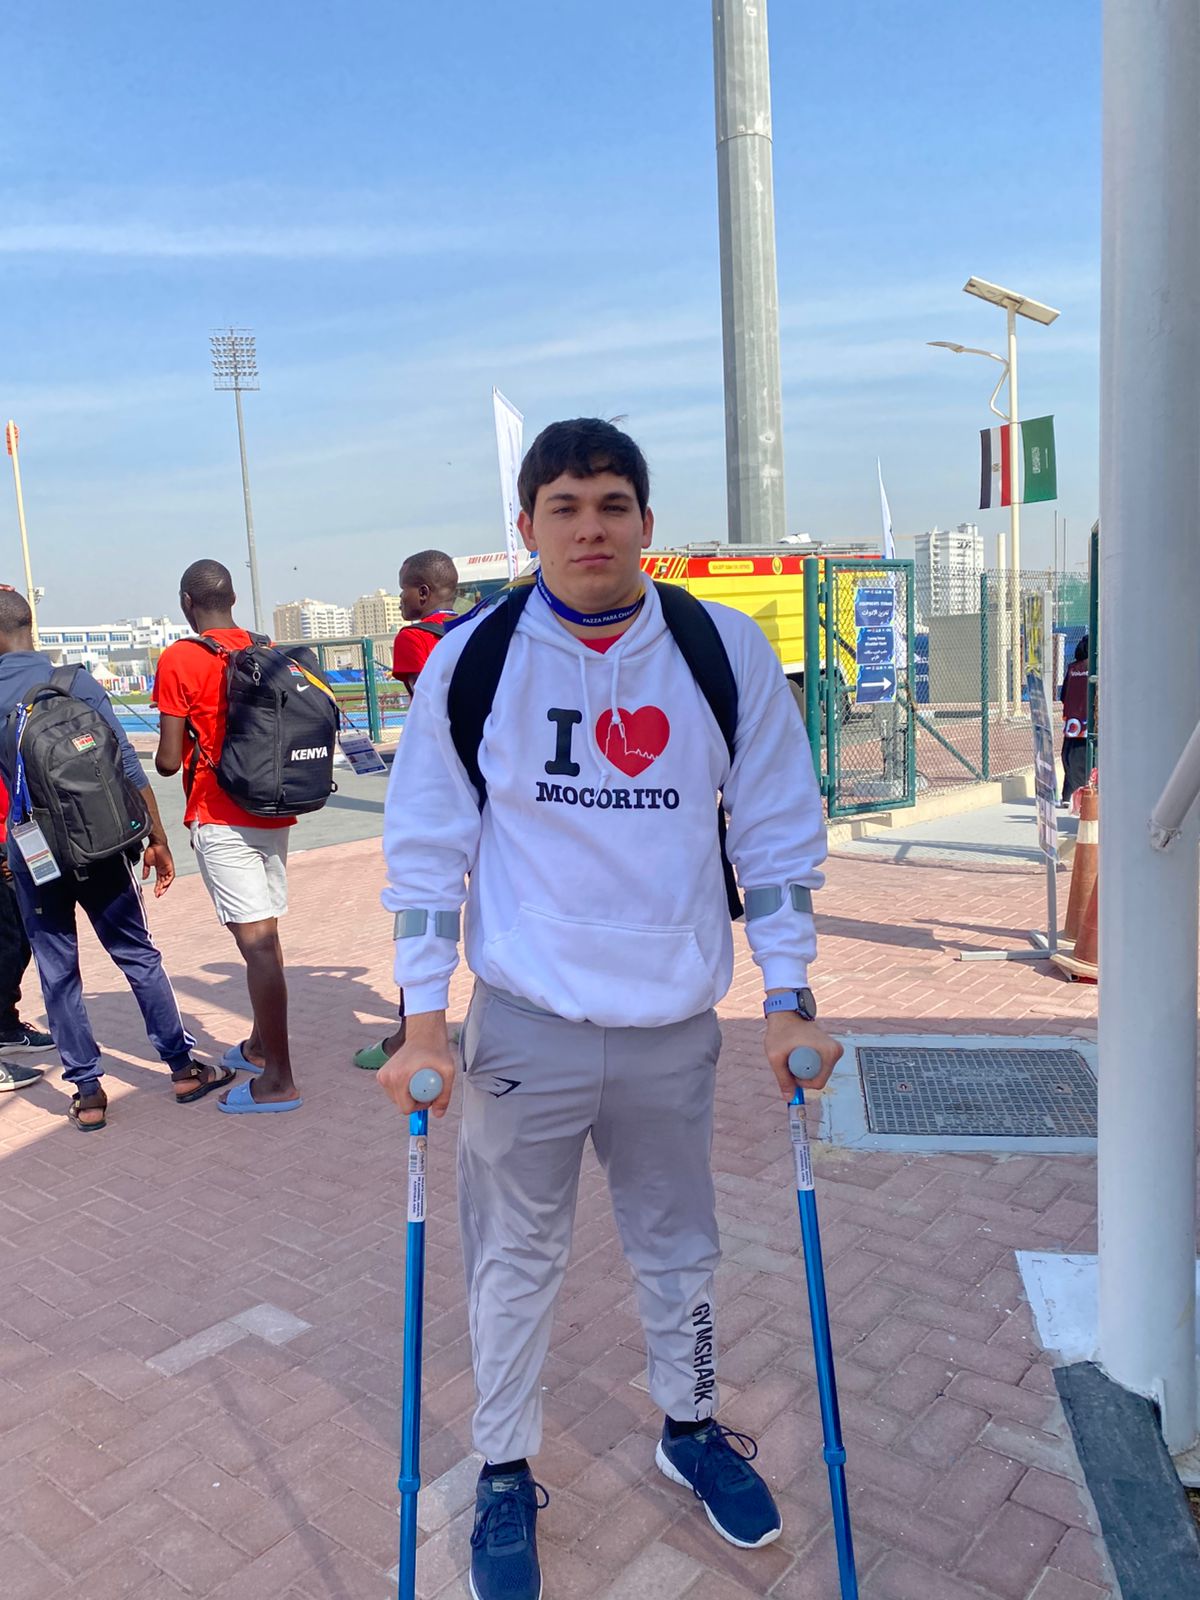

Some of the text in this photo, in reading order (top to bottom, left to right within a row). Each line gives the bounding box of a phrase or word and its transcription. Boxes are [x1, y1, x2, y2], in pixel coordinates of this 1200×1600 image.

[291, 746, 328, 761] KENYA
[544, 707, 582, 777] I
[535, 781, 680, 810] MOCORITO
[692, 1302, 715, 1406] GYMSHARK
